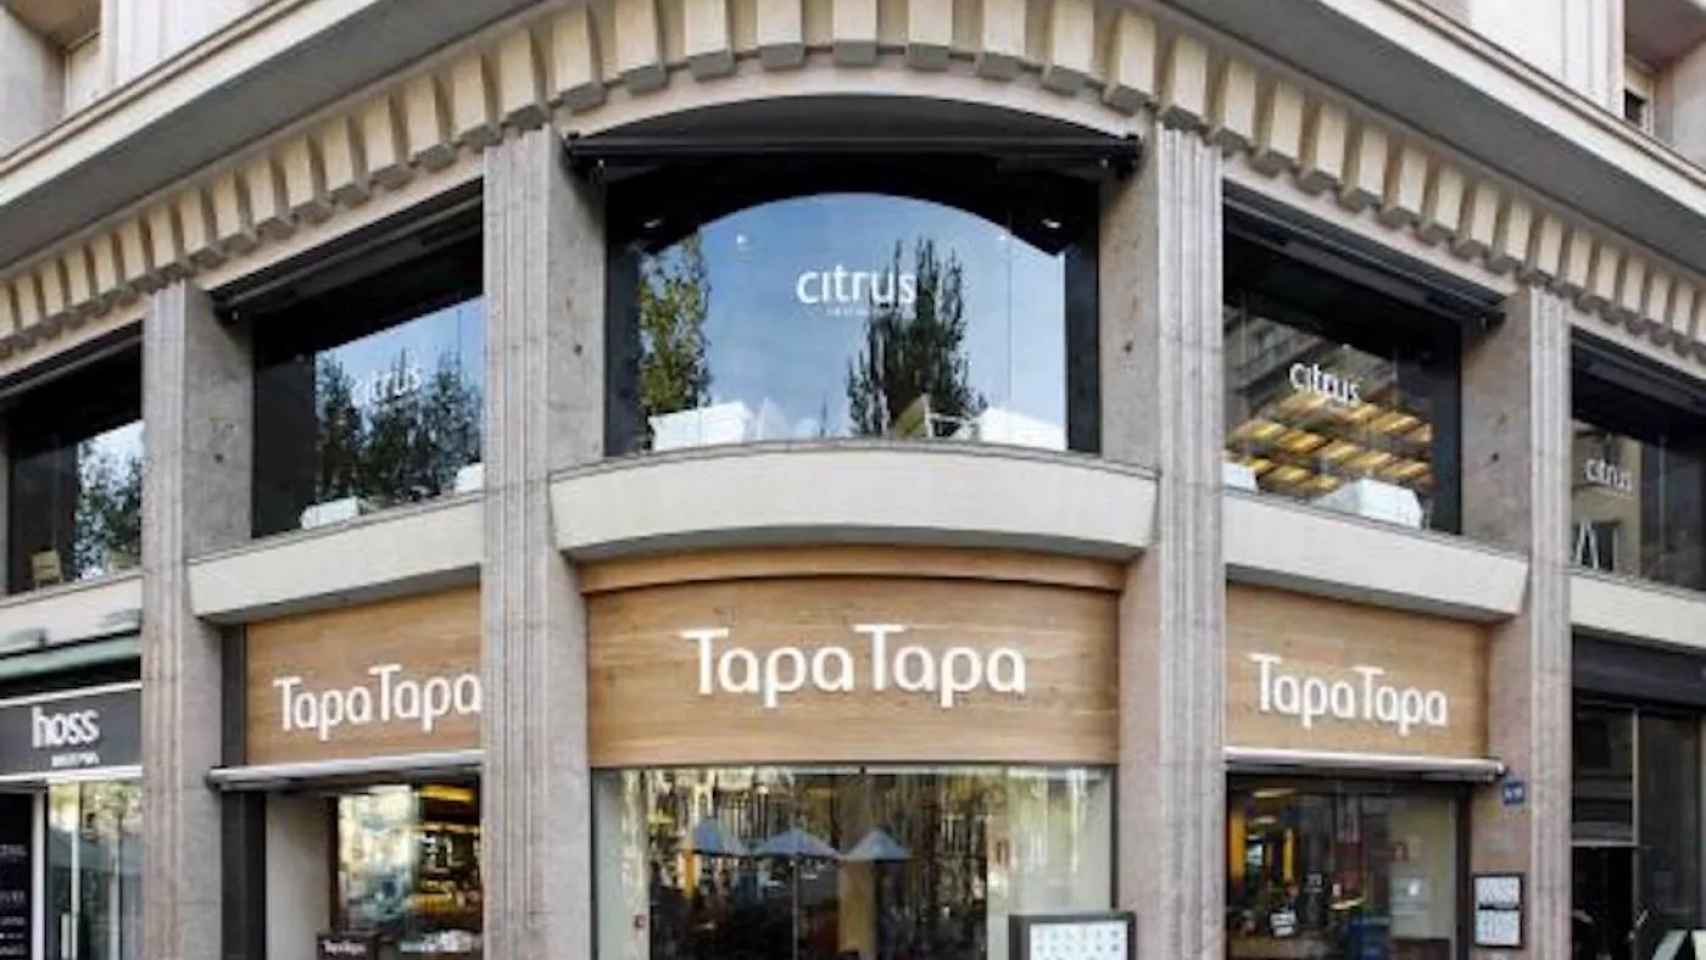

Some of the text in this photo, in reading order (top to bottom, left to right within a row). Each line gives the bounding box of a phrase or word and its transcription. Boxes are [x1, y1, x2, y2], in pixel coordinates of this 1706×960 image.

[797, 264, 917, 304] citrus
[1289, 363, 1361, 407] citrus
[32, 706, 99, 748] hoss
